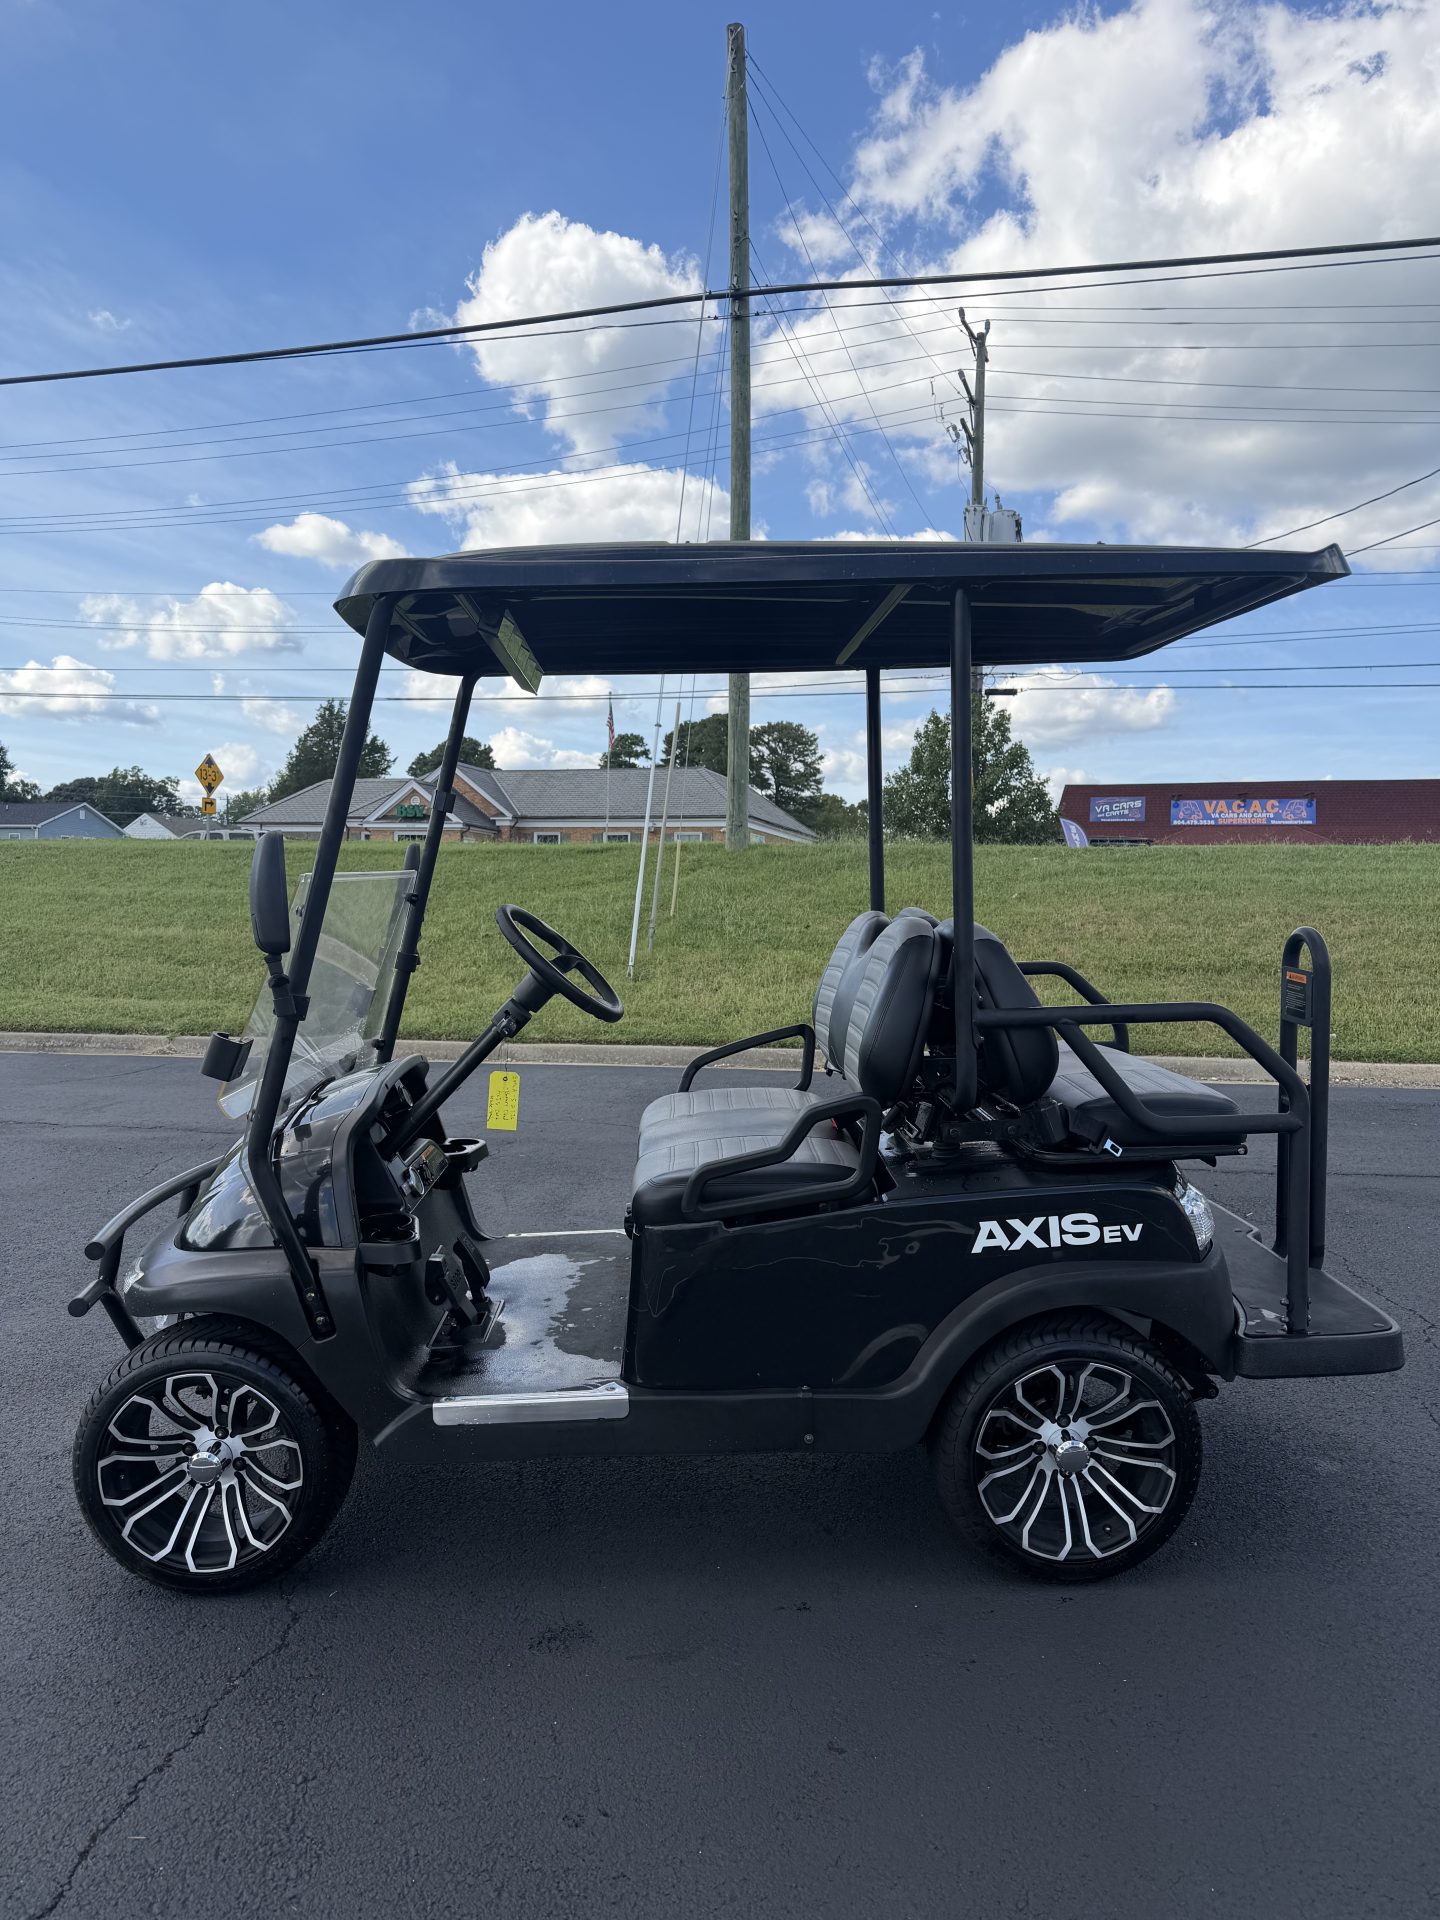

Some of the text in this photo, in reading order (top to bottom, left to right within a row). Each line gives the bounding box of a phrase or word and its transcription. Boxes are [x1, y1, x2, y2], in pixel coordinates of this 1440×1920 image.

[1095, 799, 1142, 813] VA CARS
[971, 1212, 1144, 1254] AXIS EV
